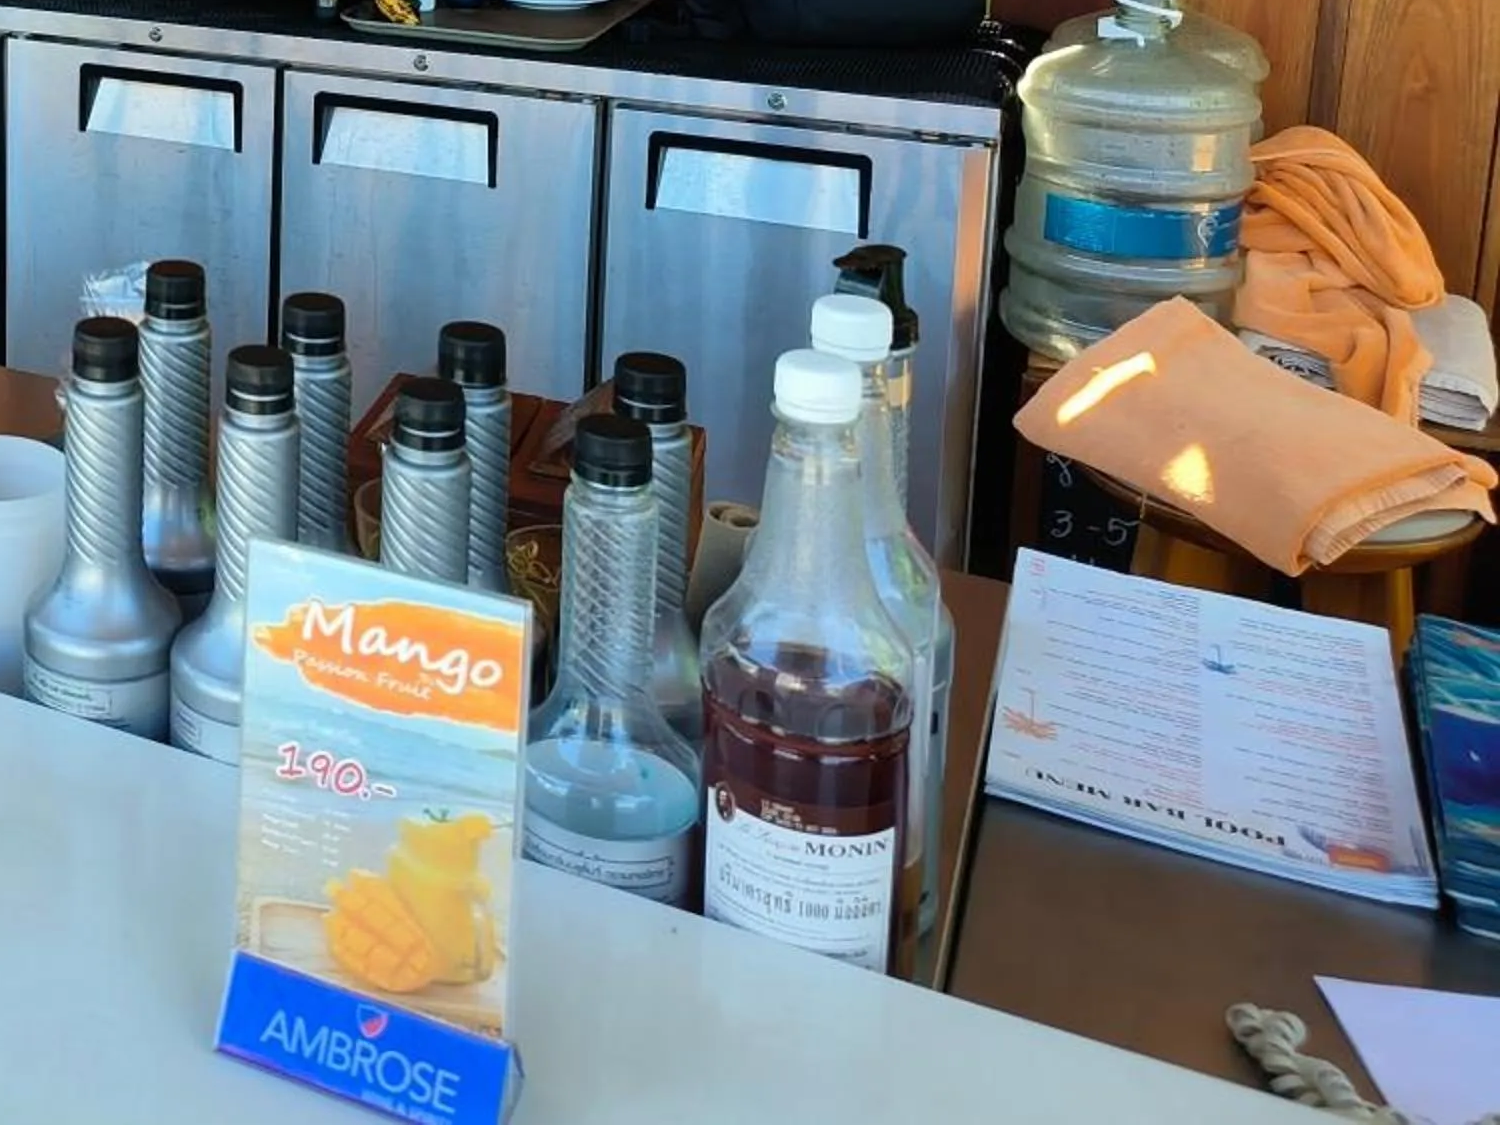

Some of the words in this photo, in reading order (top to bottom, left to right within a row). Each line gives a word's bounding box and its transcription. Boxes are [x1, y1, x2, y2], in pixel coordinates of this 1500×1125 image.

[301, 600, 503, 695] Mango
[292, 648, 372, 683] Passion
[376, 671, 432, 701] Fruit
[275, 741, 398, 802] 190.-
[1123, 795, 1186, 821] BAR
[1204, 816, 1286, 847] POOL
[803, 837, 889, 859] MONIN
[259, 1008, 461, 1115] AMBROSE
